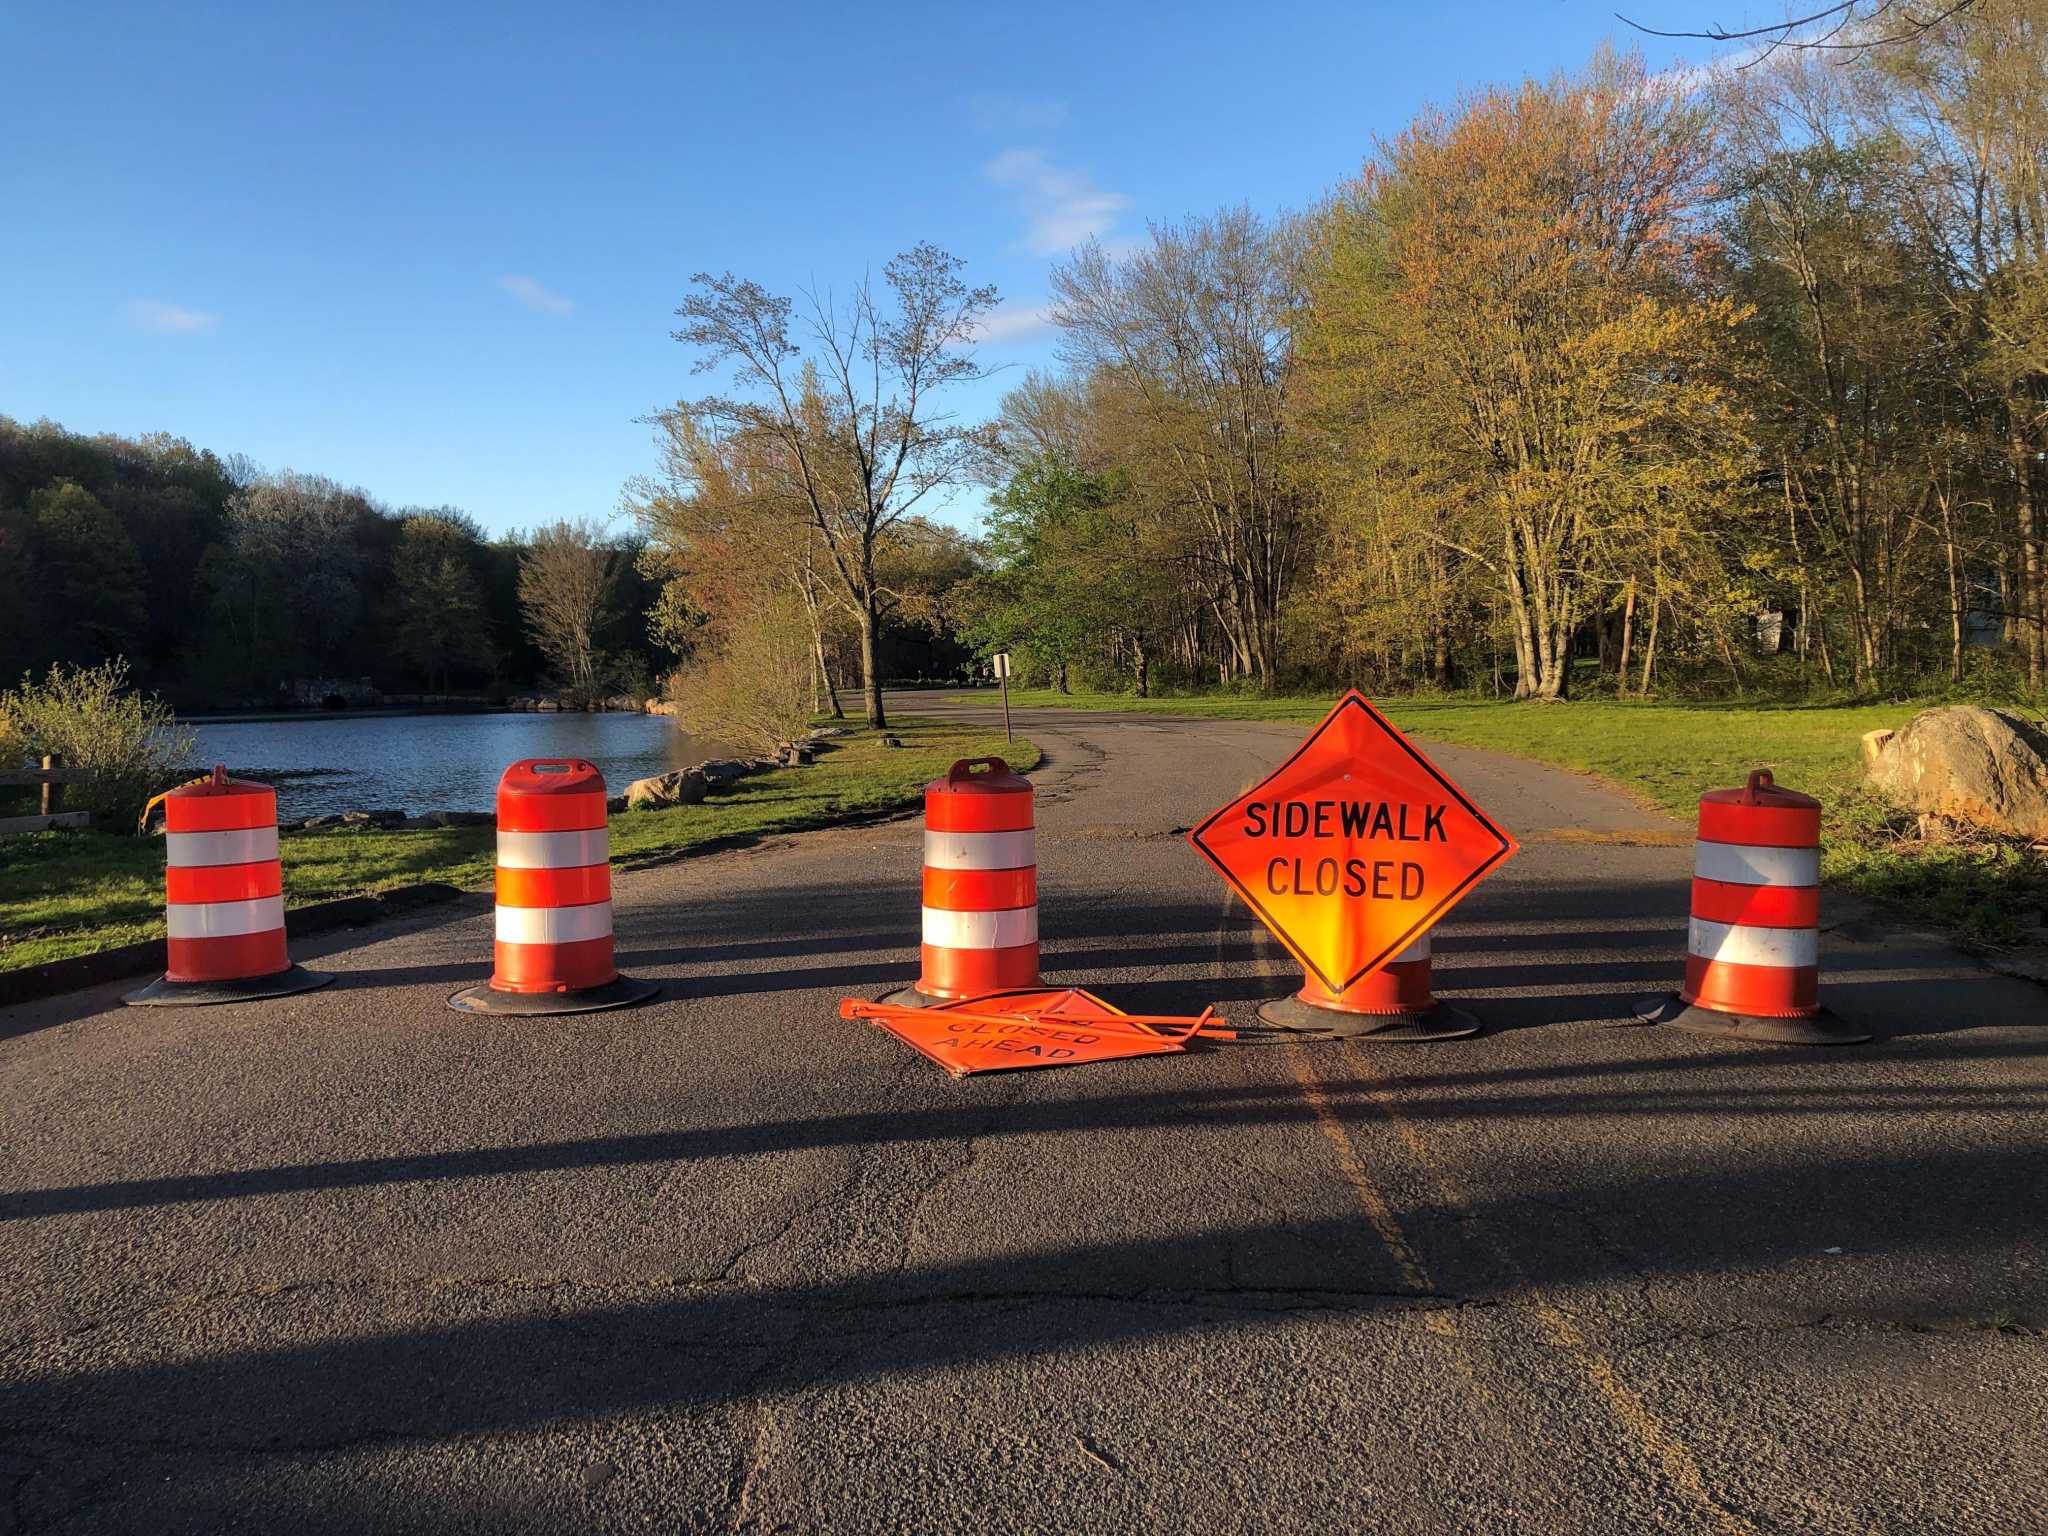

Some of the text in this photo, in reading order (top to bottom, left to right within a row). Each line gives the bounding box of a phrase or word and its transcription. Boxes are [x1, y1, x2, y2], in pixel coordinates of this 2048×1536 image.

[1243, 801, 1448, 842] SIDEWALK
[1266, 857, 1425, 901] CLOSED
[932, 1037, 1075, 1058] AHEAD
[948, 1023, 1100, 1044] CLOSED
